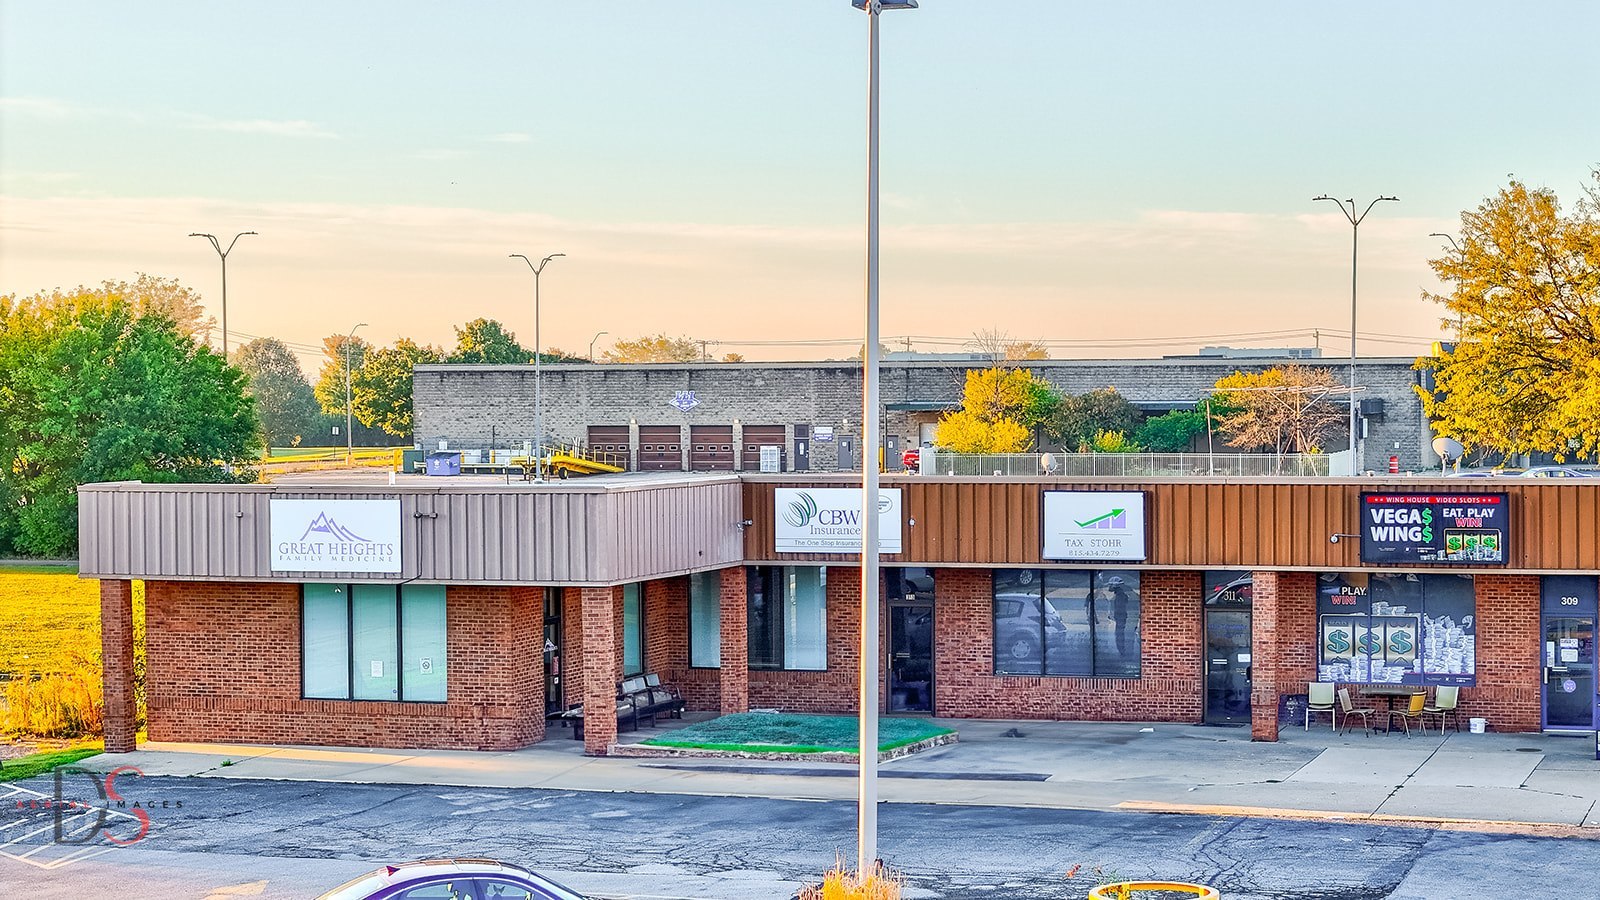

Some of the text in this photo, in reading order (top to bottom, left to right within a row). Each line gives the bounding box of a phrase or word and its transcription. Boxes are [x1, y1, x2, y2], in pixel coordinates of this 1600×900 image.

[818, 509, 860, 525] CBW
[1468, 508, 1495, 517] PLAY
[1455, 517, 1483, 527] WIN!
[810, 525, 862, 535] Insurance
[820, 540, 835, 548] Stop
[1065, 539, 1122, 547] TAX STOHR
[279, 542, 393, 556] GREAT HEIGHTS
[1223, 591, 1236, 600] 311
[1331, 595, 1357, 604] WIN!
[1561, 597, 1578, 605] 309
